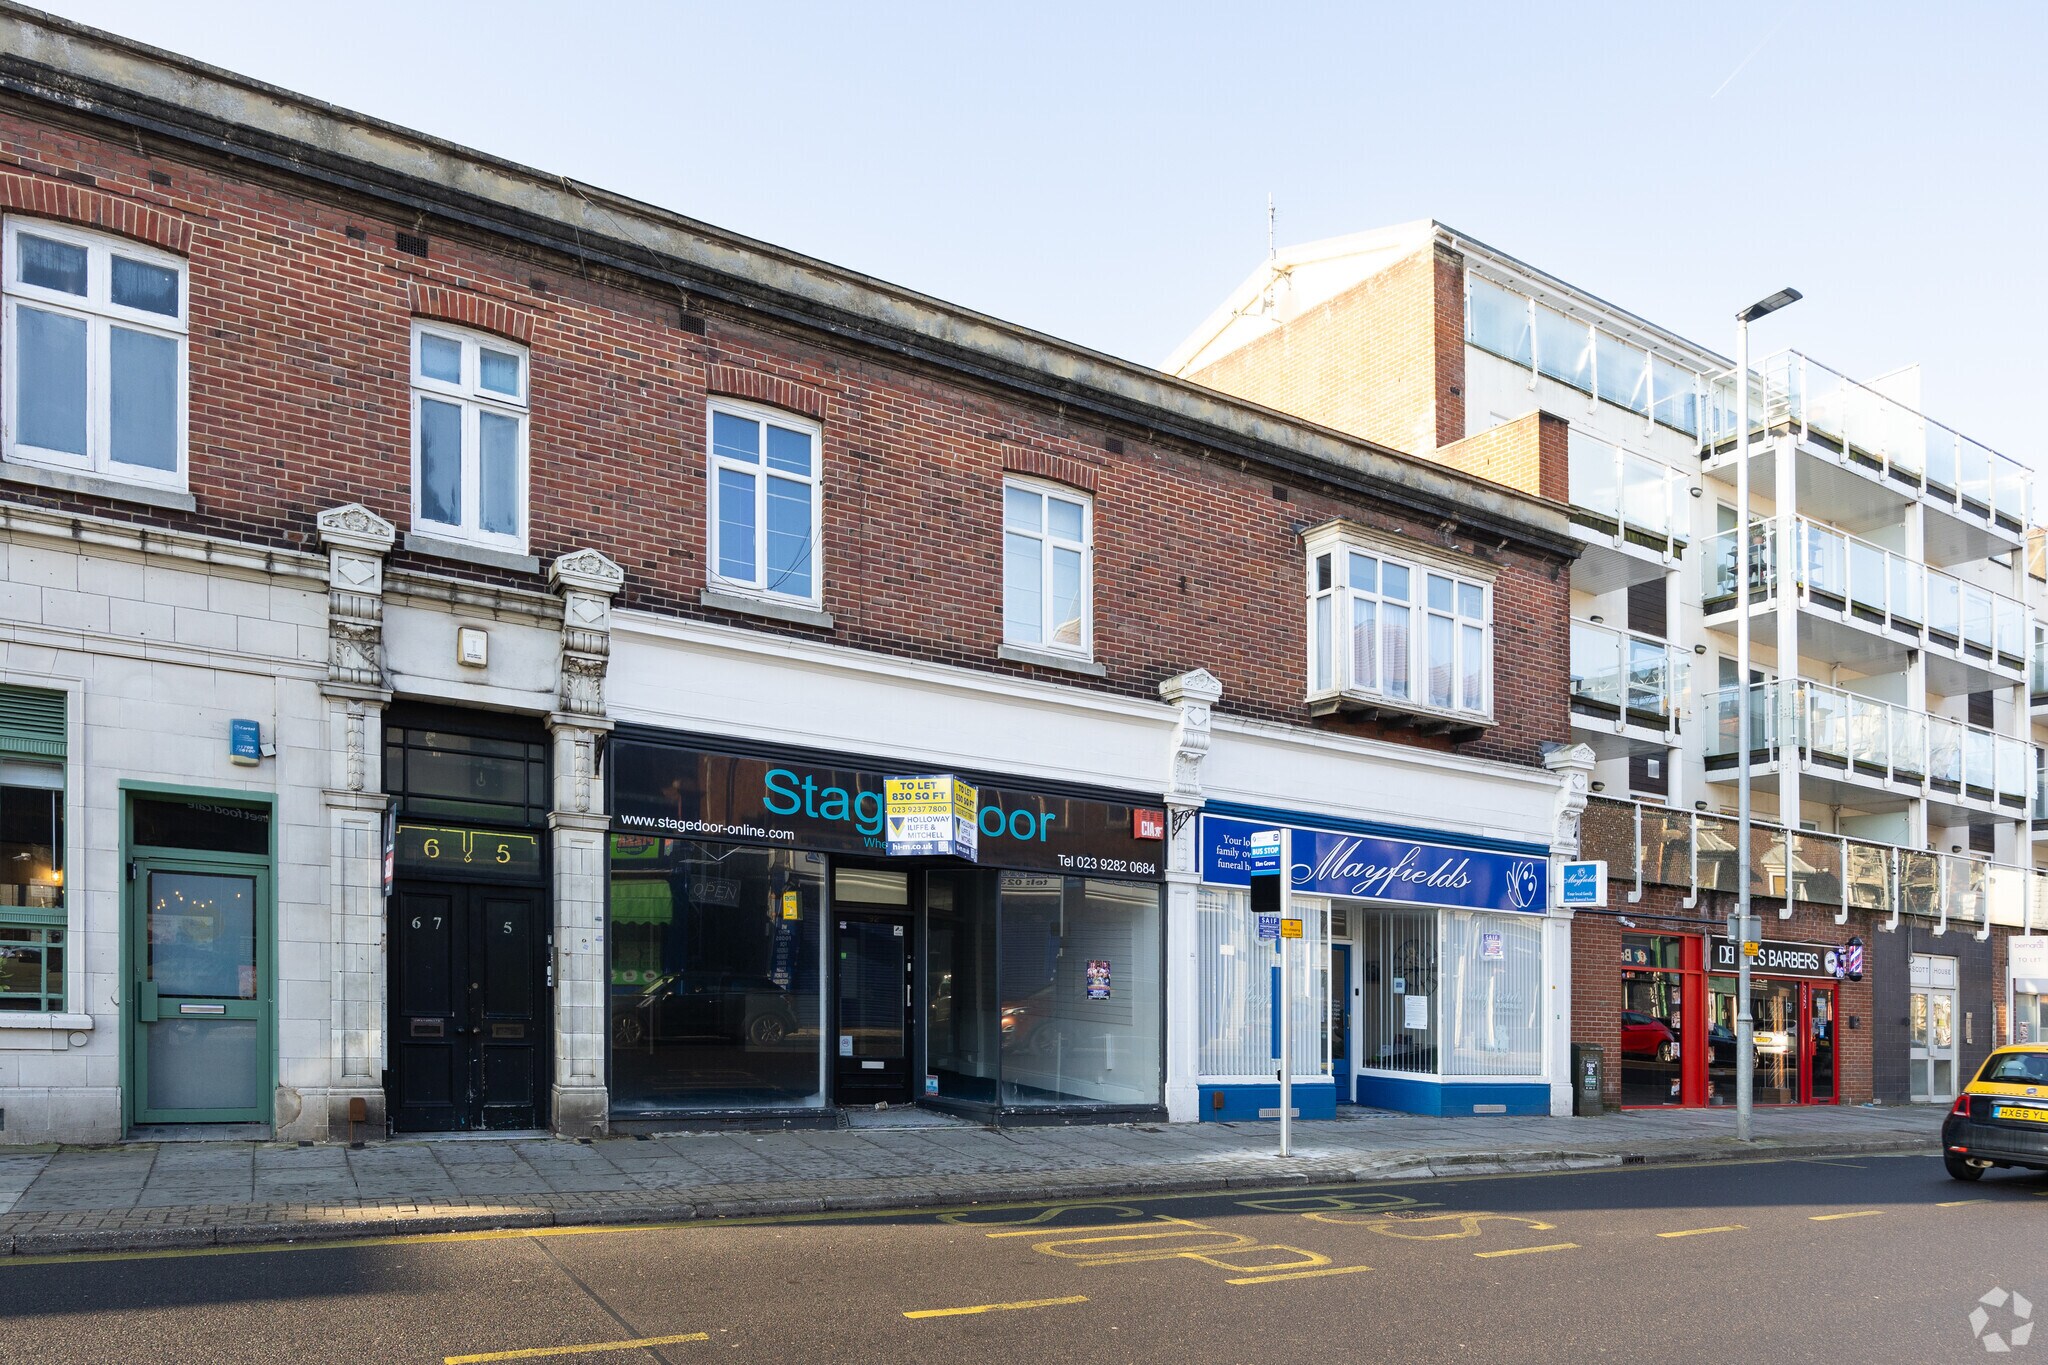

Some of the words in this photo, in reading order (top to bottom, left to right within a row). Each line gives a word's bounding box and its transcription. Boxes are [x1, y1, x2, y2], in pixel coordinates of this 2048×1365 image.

[900, 782, 915, 790] TO
[918, 781, 937, 790] LET
[958, 784, 965, 793] TO
[964, 788, 972, 798] LET
[892, 792, 912, 801] 830
[915, 793, 930, 801] SQ
[932, 792, 945, 800] FT
[763, 769, 885, 835] Stag
[979, 806, 1056, 842] oor
[928, 805, 947, 813] 7800
[907, 815, 950, 823] HOLLOWAY
[621, 814, 795, 840] www.stagedoor-online.com
[1141, 821, 1155, 837] CIA
[864, 836, 888, 850] Whe
[892, 842, 933, 851] hi-m.co.uk
[1223, 834, 1242, 846] Your
[423, 838, 440, 858] 6
[495, 844, 511, 864] 5
[1216, 845, 1240, 860] family
[1252, 848, 1263, 856] BUS
[1263, 847, 1279, 855] STOP
[1058, 854, 1074, 867] Tel
[1077, 856, 1098, 869] 023
[1100, 860, 1127, 872] 9282
[1130, 861, 1156, 875] 0684
[1217, 858, 1244, 871] funeral
[1289, 836, 1472, 897] Mayfields
[693, 882, 738, 900] OPEN
[412, 916, 421, 929] 6
[433, 916, 442, 930] 7
[503, 921, 512, 934] 5
[1261, 917, 1277, 925] SAIF
[1768, 950, 1819, 970] BARBERS
[2000, 1108, 2029, 1119] HX66
[2034, 1110, 2047, 1120] YL
[935, 1203, 1333, 1272] STOP
